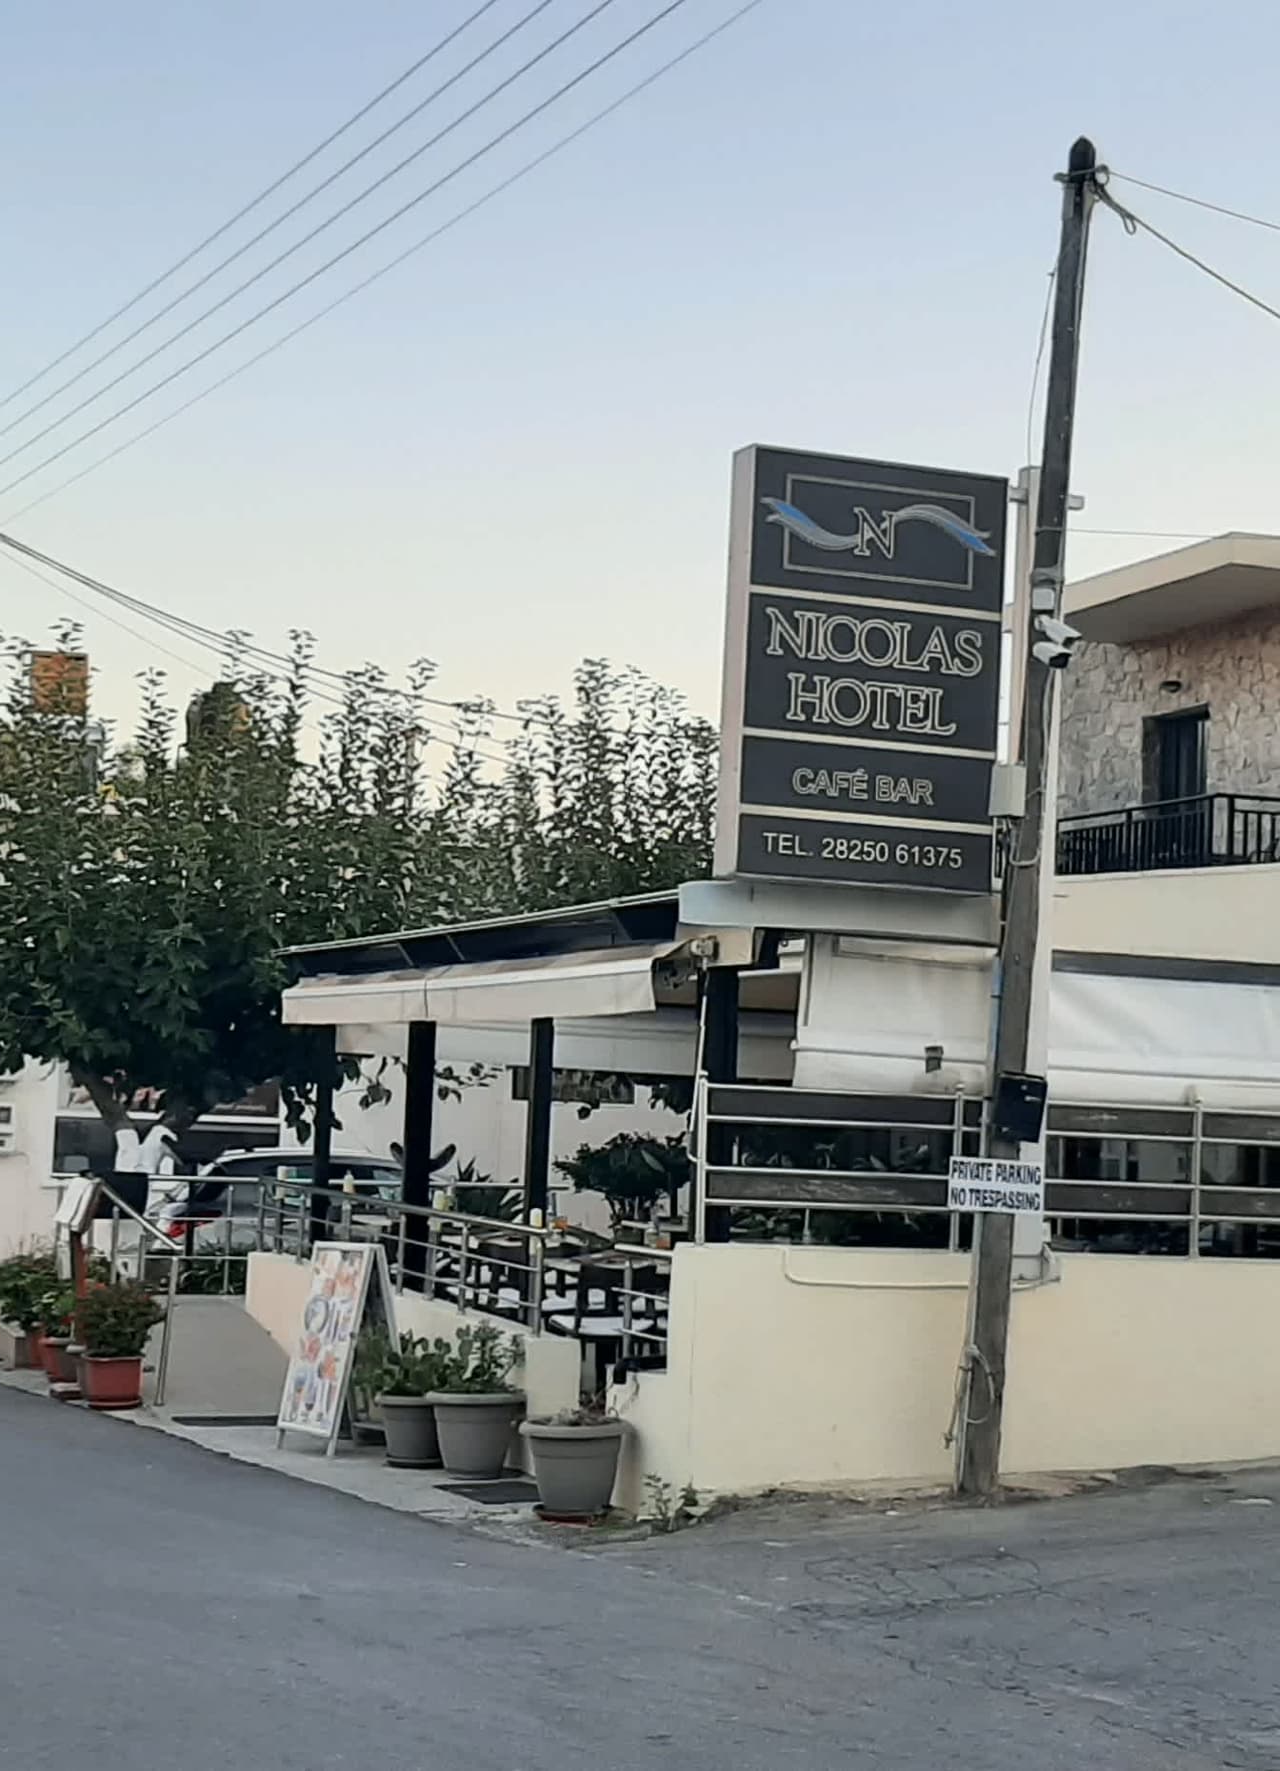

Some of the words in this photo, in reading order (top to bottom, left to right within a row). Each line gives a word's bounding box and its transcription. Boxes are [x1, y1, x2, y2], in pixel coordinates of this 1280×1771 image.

[853, 506, 897, 560] N
[765, 607, 983, 677] NICOLAS
[786, 672, 957, 736] HOTEL
[792, 768, 869, 800] CAFÉ
[875, 776, 935, 805] BAR
[763, 832, 815, 857] TEL.
[821, 837, 889, 863] 28250
[895, 842, 963, 868] 61375
[951, 1160, 992, 1182] PRIVATE
[995, 1163, 1041, 1185] PARKING
[951, 1188, 966, 1206] NO
[968, 1188, 1041, 1211] TRESPASSING
